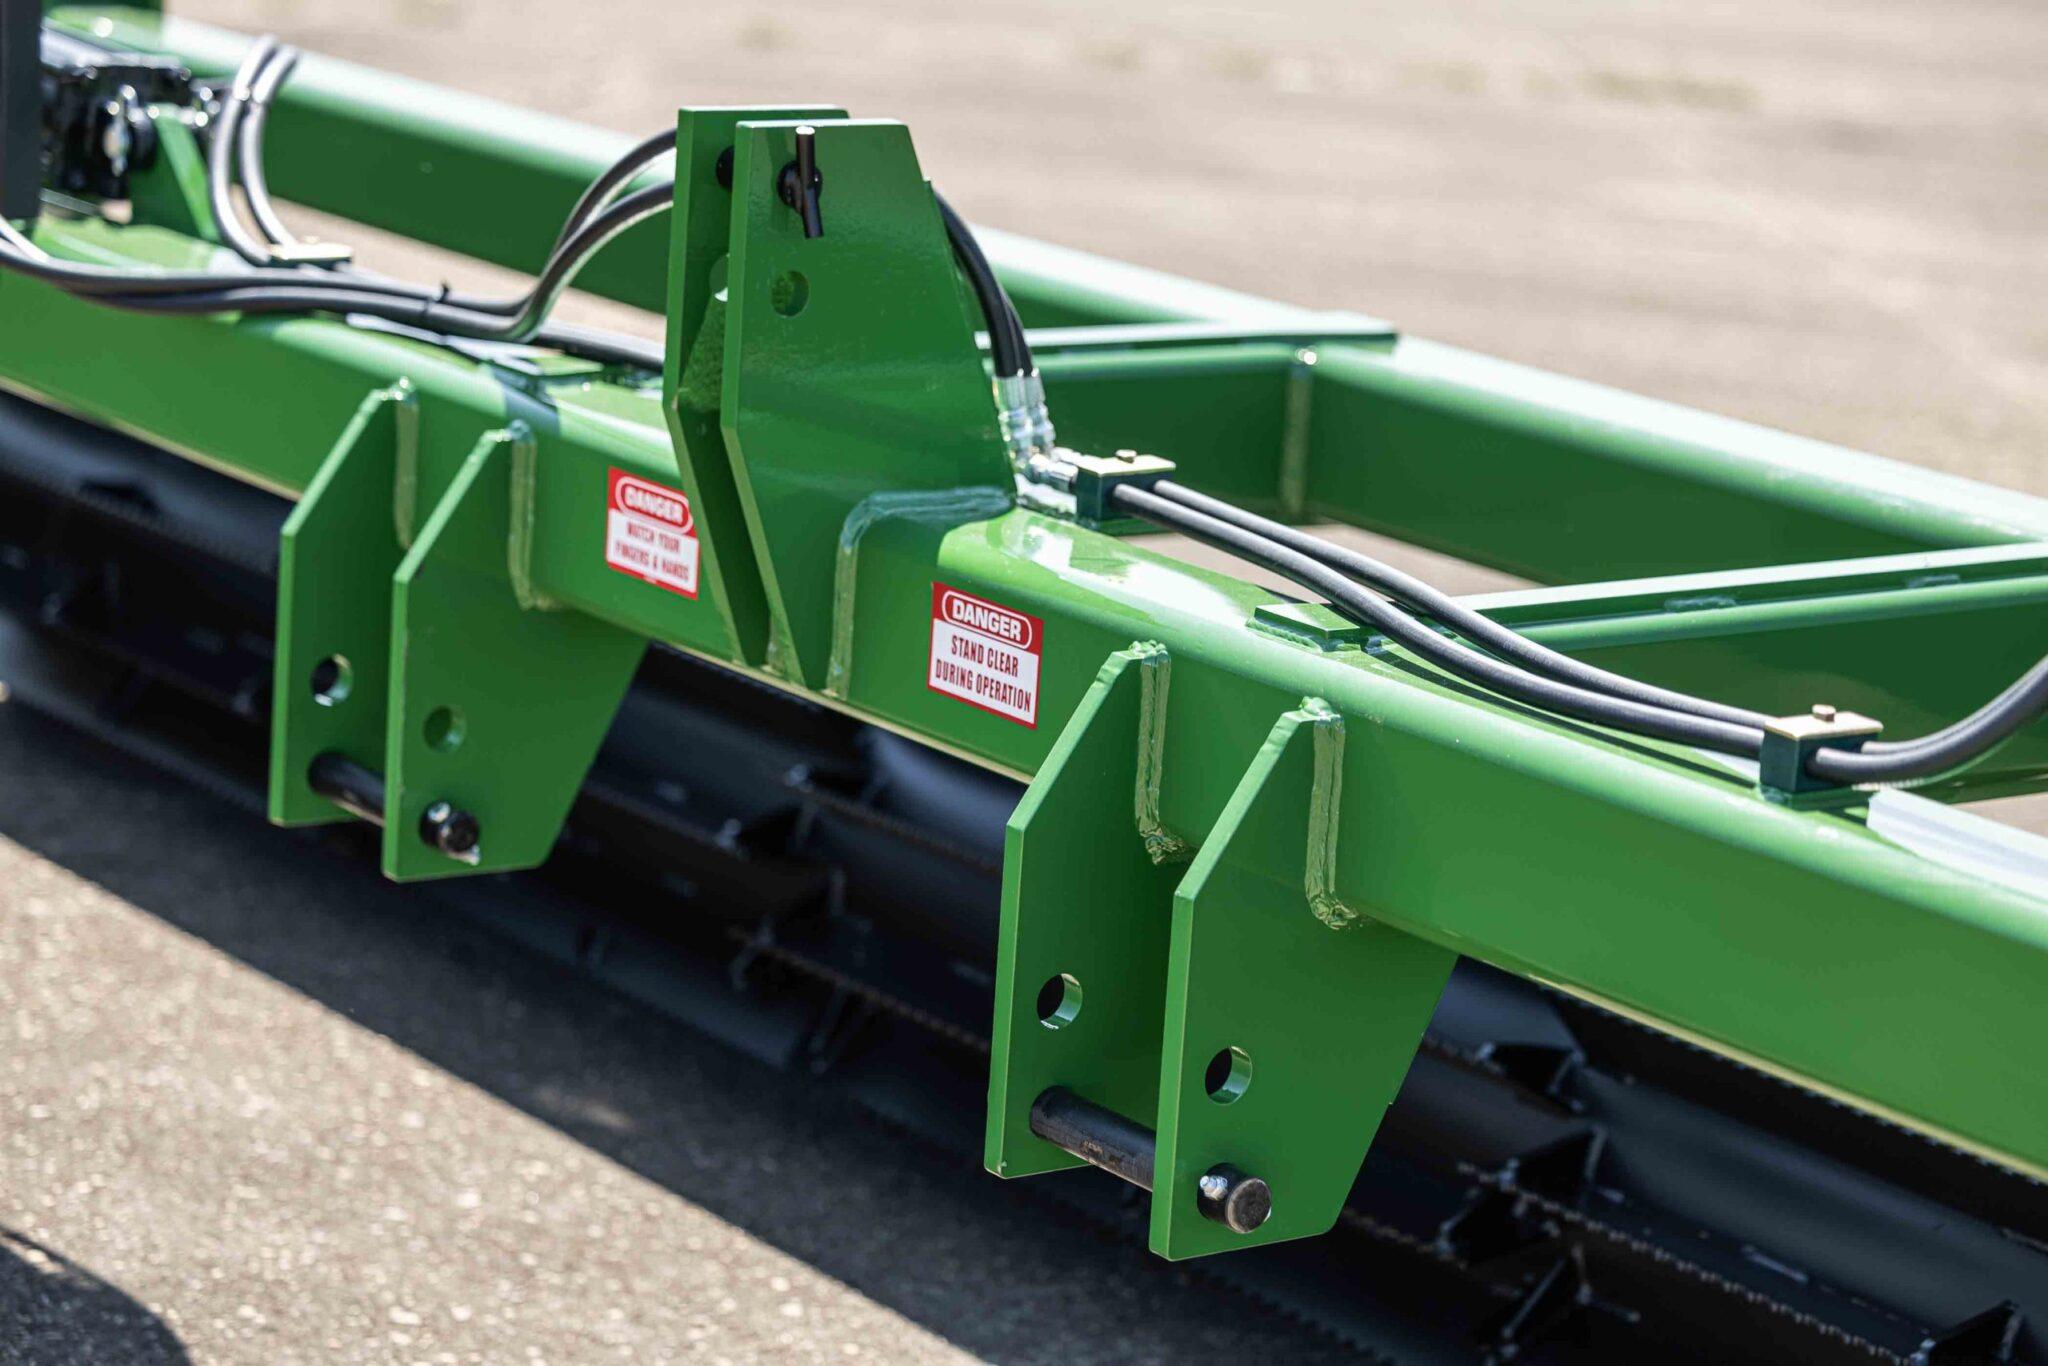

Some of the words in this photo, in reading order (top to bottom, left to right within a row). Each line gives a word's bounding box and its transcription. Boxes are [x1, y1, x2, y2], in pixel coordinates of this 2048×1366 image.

[625, 485, 683, 523] DANGER
[952, 598, 1022, 642] DANGER
[951, 634, 984, 664] STAND
[987, 647, 1019, 677] CLEAR
[936, 658, 973, 690] DURING
[975, 673, 1031, 713] OPERATION
